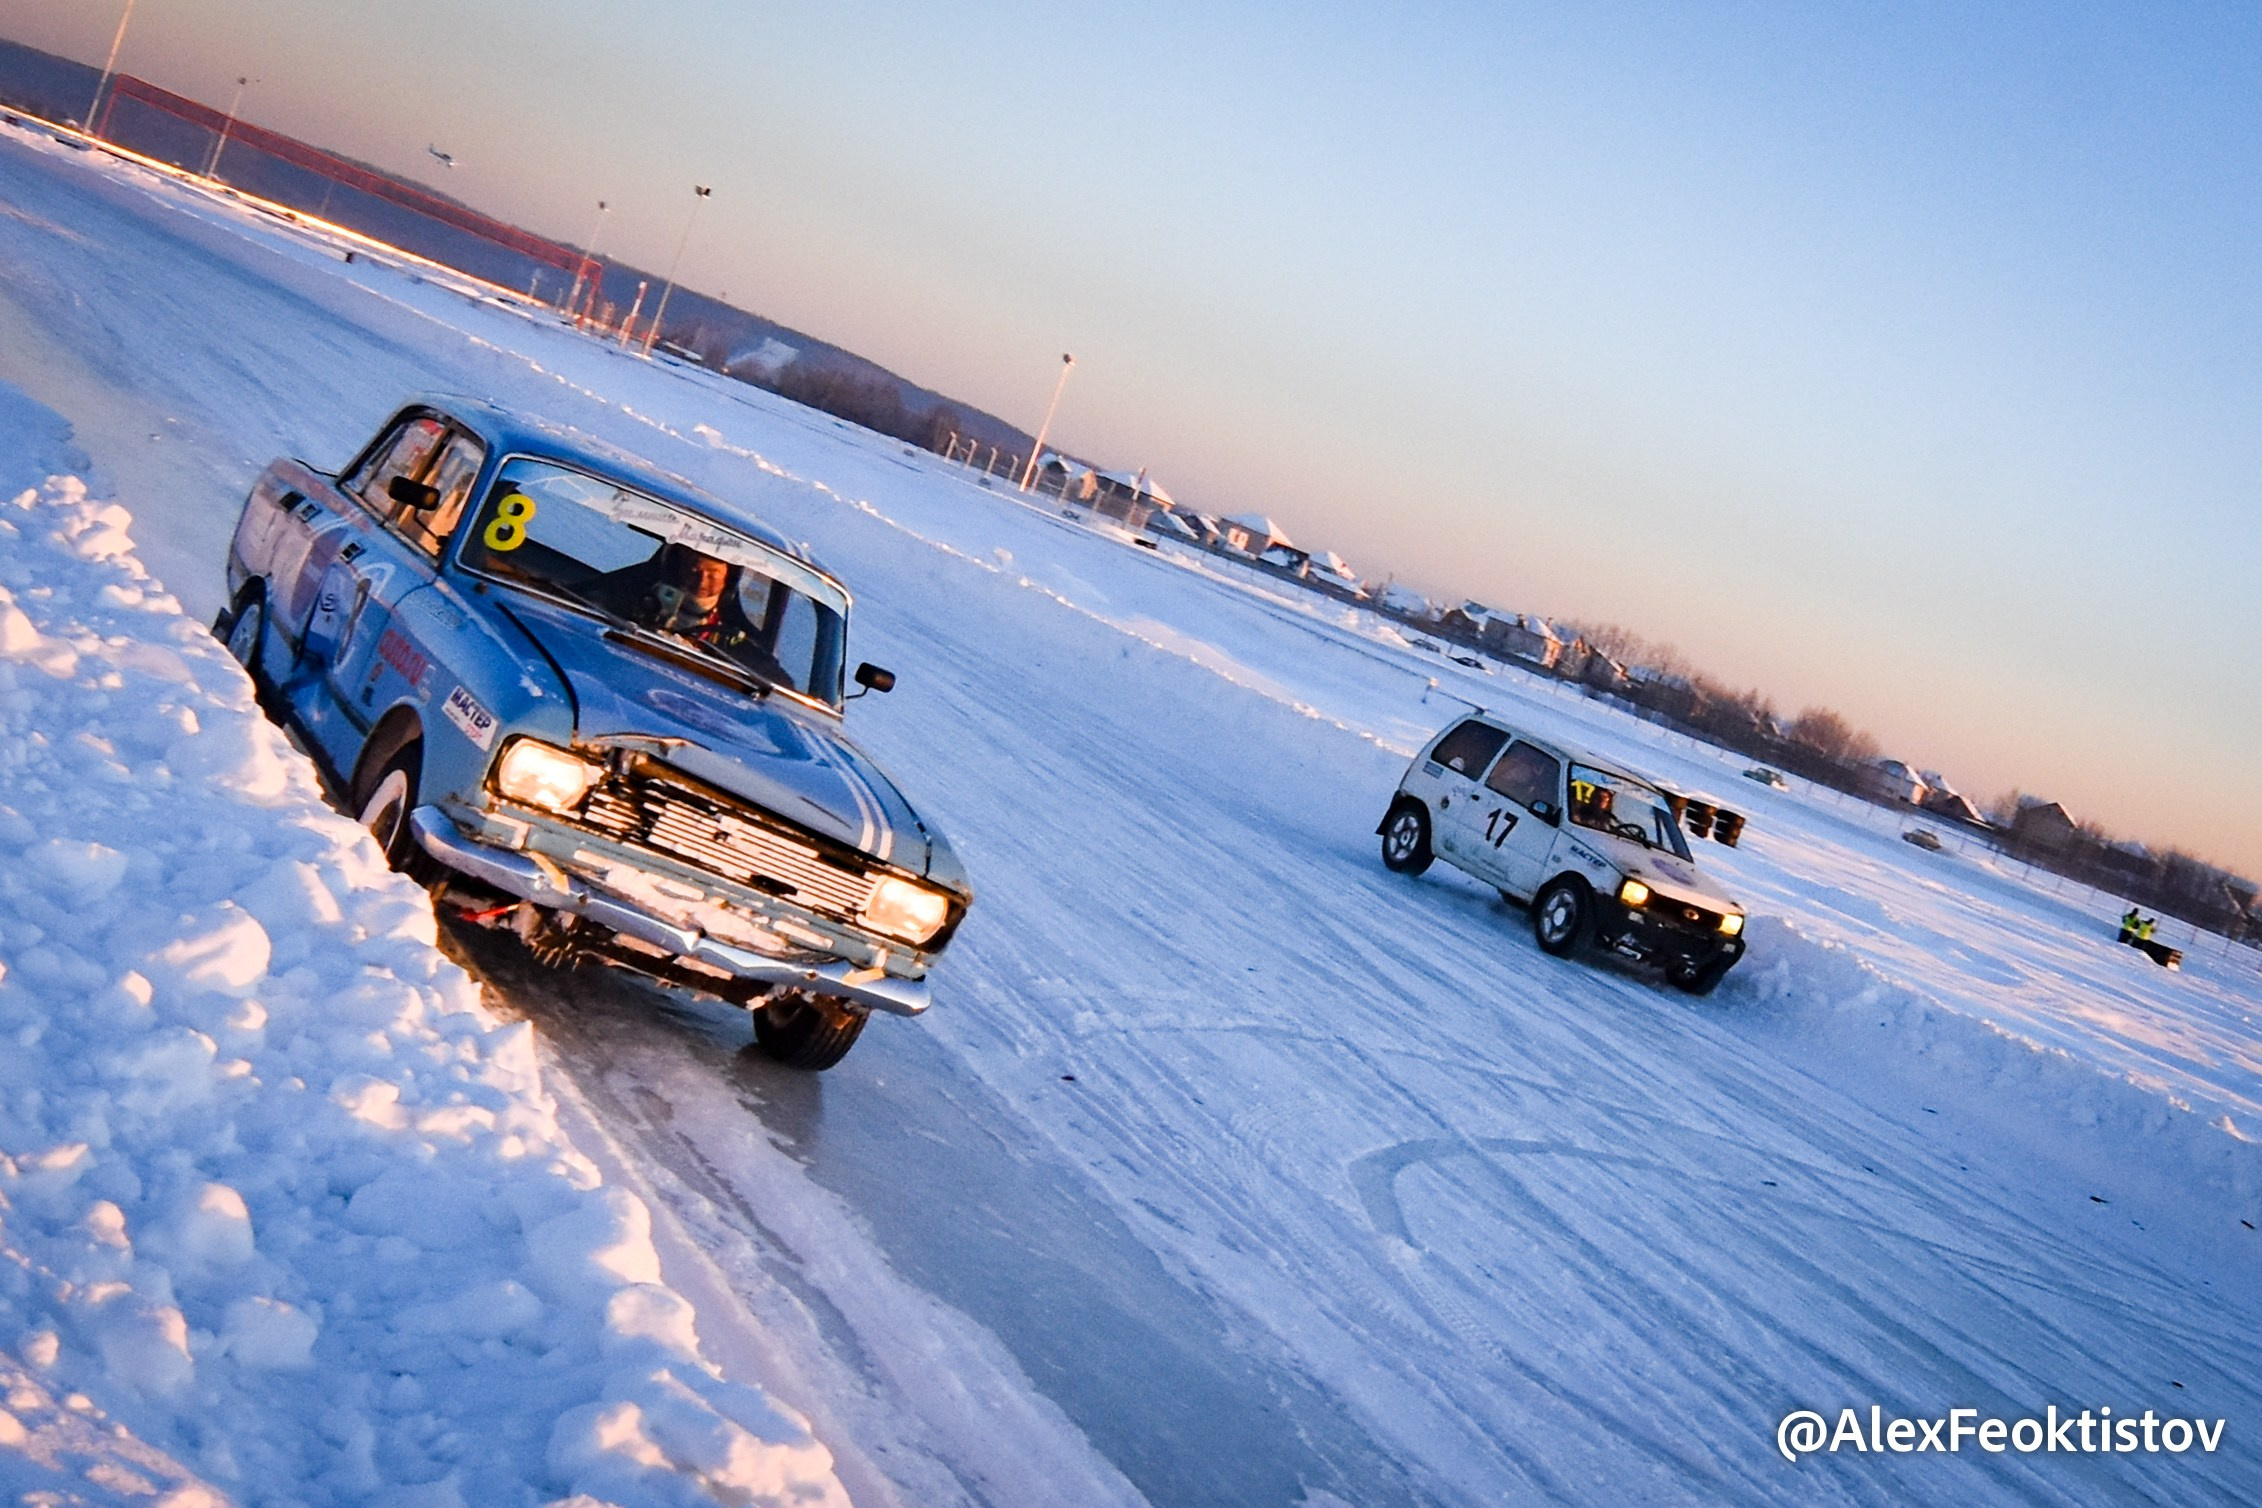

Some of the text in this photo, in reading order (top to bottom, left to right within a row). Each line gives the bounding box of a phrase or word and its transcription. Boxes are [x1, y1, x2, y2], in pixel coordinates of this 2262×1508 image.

[484, 493, 536, 551] 8
[450, 687, 492, 729] МАСТЕР
[1570, 780, 1596, 804] 17
[1485, 808, 1519, 850] 17
